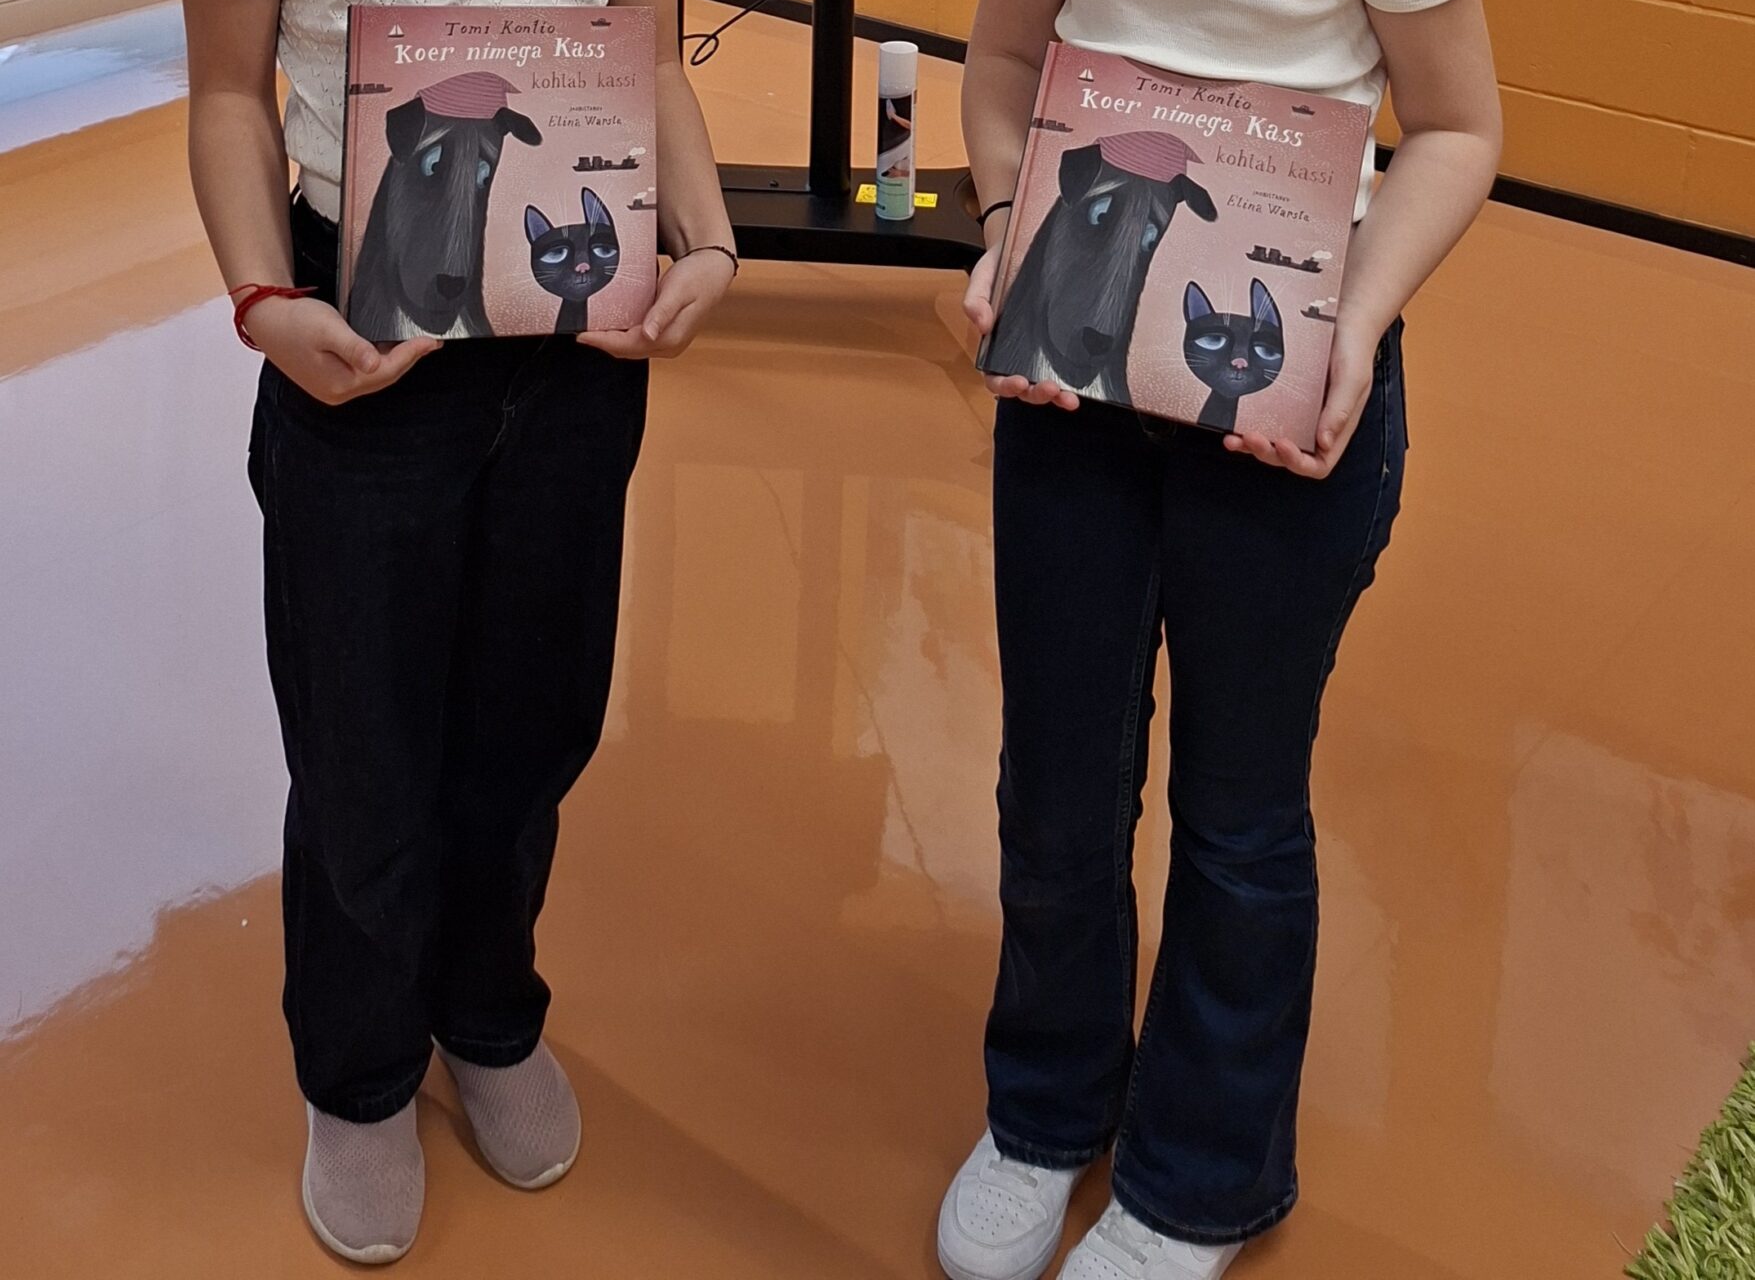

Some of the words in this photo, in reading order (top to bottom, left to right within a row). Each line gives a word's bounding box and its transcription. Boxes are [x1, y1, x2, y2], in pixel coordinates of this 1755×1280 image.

[444, 20, 492, 37] Tomi
[500, 19, 556, 36] Kontio
[394, 42, 455, 65] Koer
[466, 41, 543, 68] nimega
[552, 37, 606, 60] Kass
[531, 71, 587, 90] kohtab
[596, 71, 637, 89] kassi
[1135, 75, 1185, 98] Tomi
[1192, 85, 1253, 111] Kontio
[548, 114, 581, 128] Elina
[1079, 87, 1142, 115] Koer
[1151, 104, 1233, 138] nimega
[1245, 114, 1305, 148] Kass
[1215, 145, 1277, 175] kohtab
[1287, 160, 1335, 186] kassi
[1226, 194, 1263, 214] Elina
